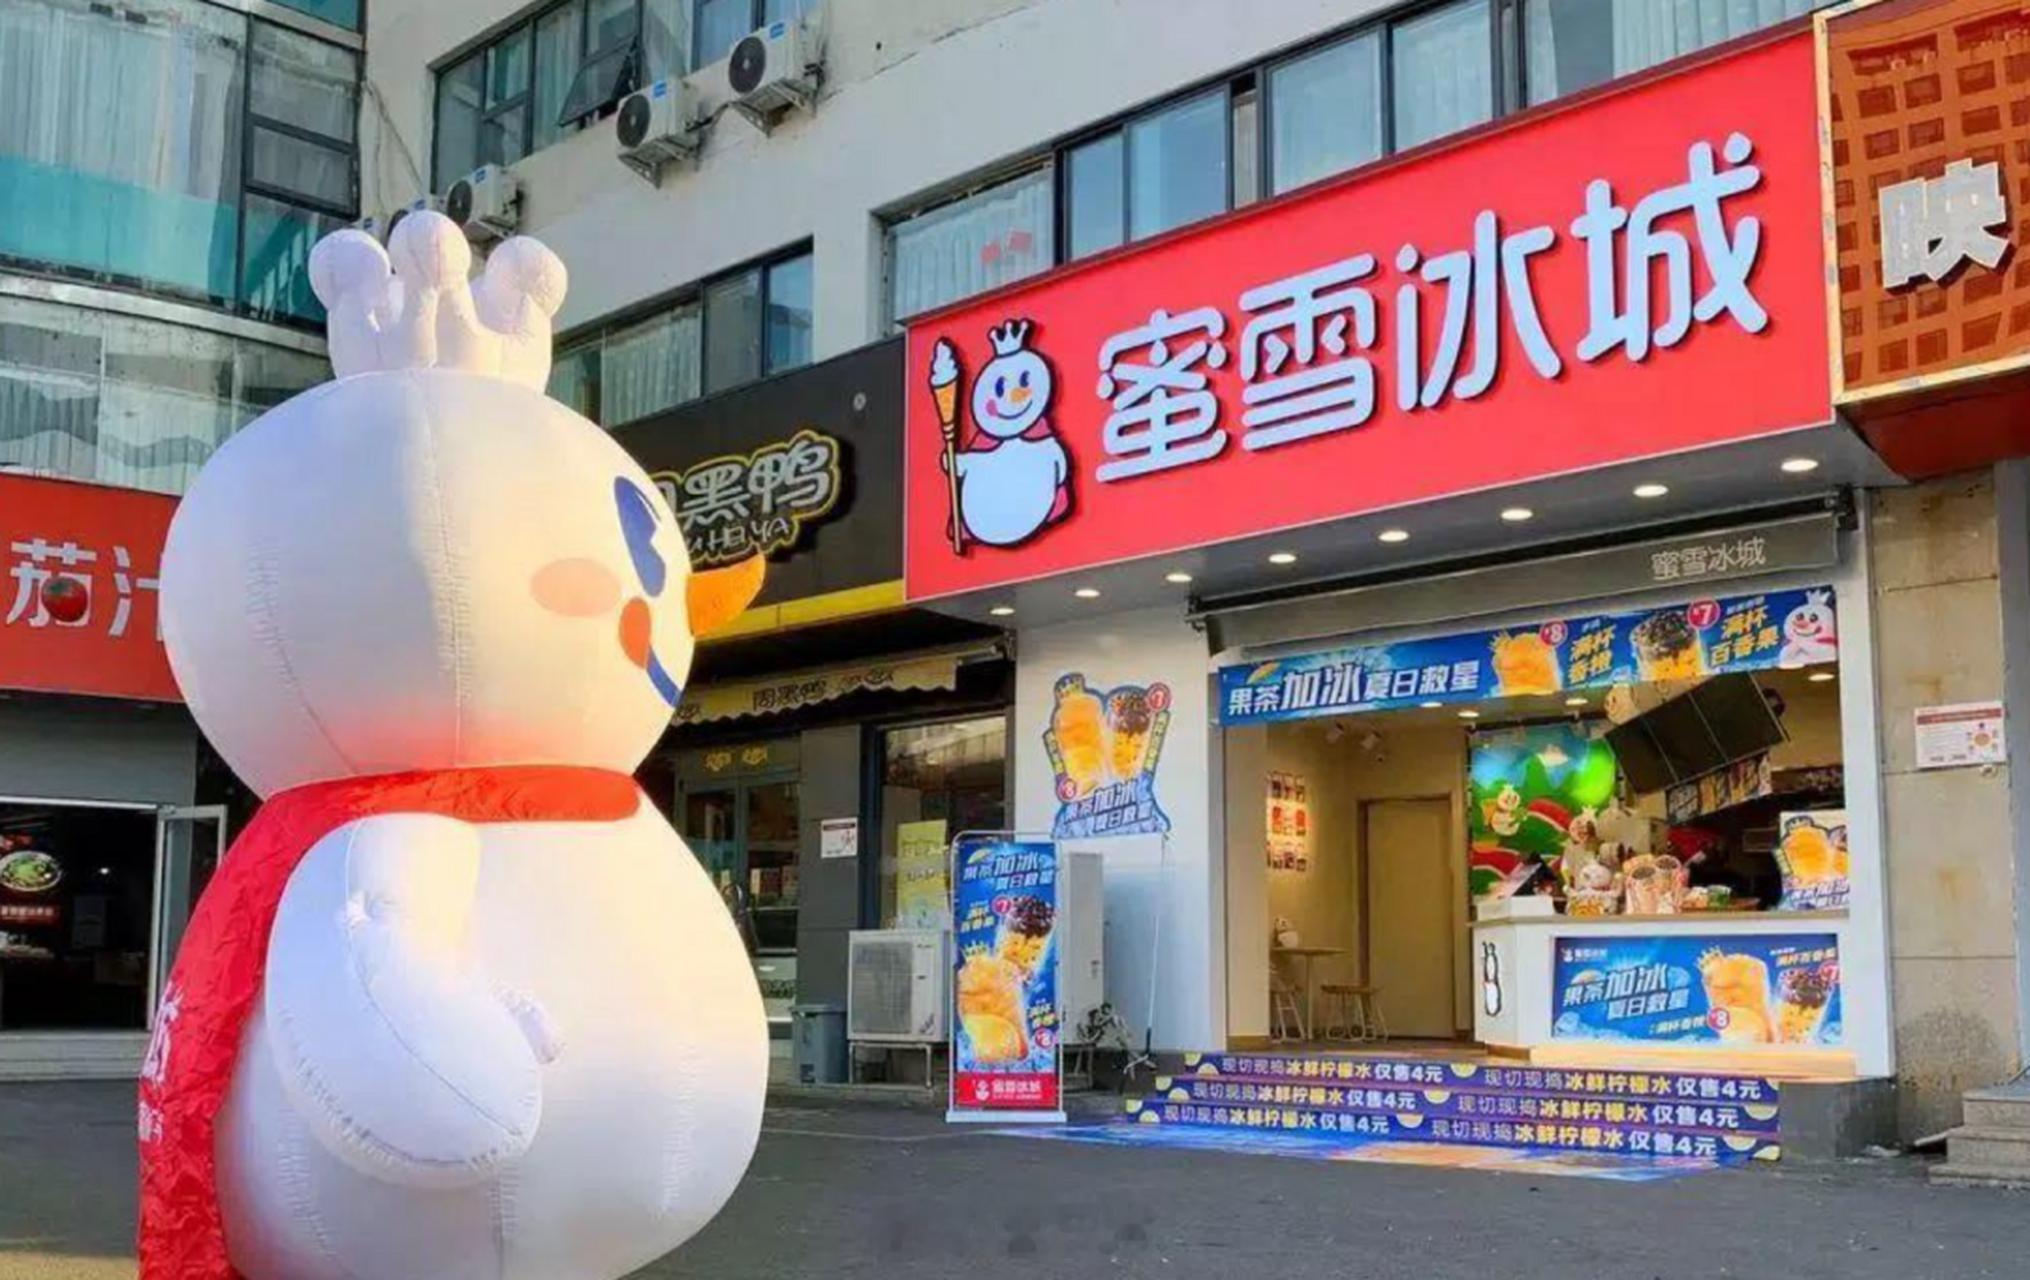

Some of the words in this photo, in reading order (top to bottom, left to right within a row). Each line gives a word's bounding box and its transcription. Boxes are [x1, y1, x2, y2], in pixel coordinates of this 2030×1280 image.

[1096, 132, 1768, 482] 蜜雪冰城
[657, 441, 830, 531] 黑鸭
[1651, 536, 1767, 580] 蜜雪冰城
